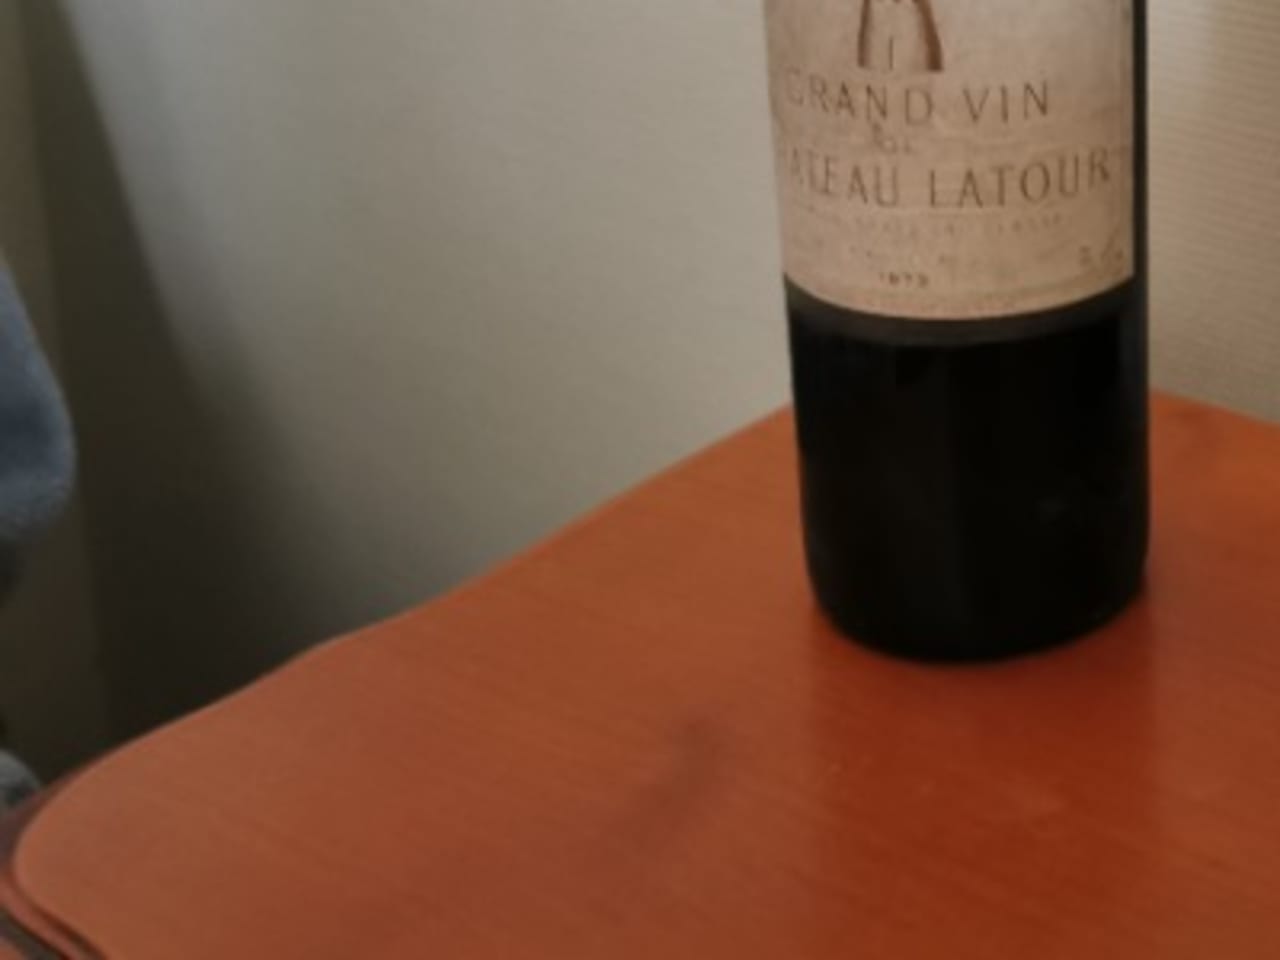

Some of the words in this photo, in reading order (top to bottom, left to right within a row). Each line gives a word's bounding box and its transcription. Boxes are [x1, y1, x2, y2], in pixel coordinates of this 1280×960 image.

[786, 66, 934, 126] GRAND
[962, 79, 1048, 125] VIN
[927, 145, 1111, 209] LATOUR
